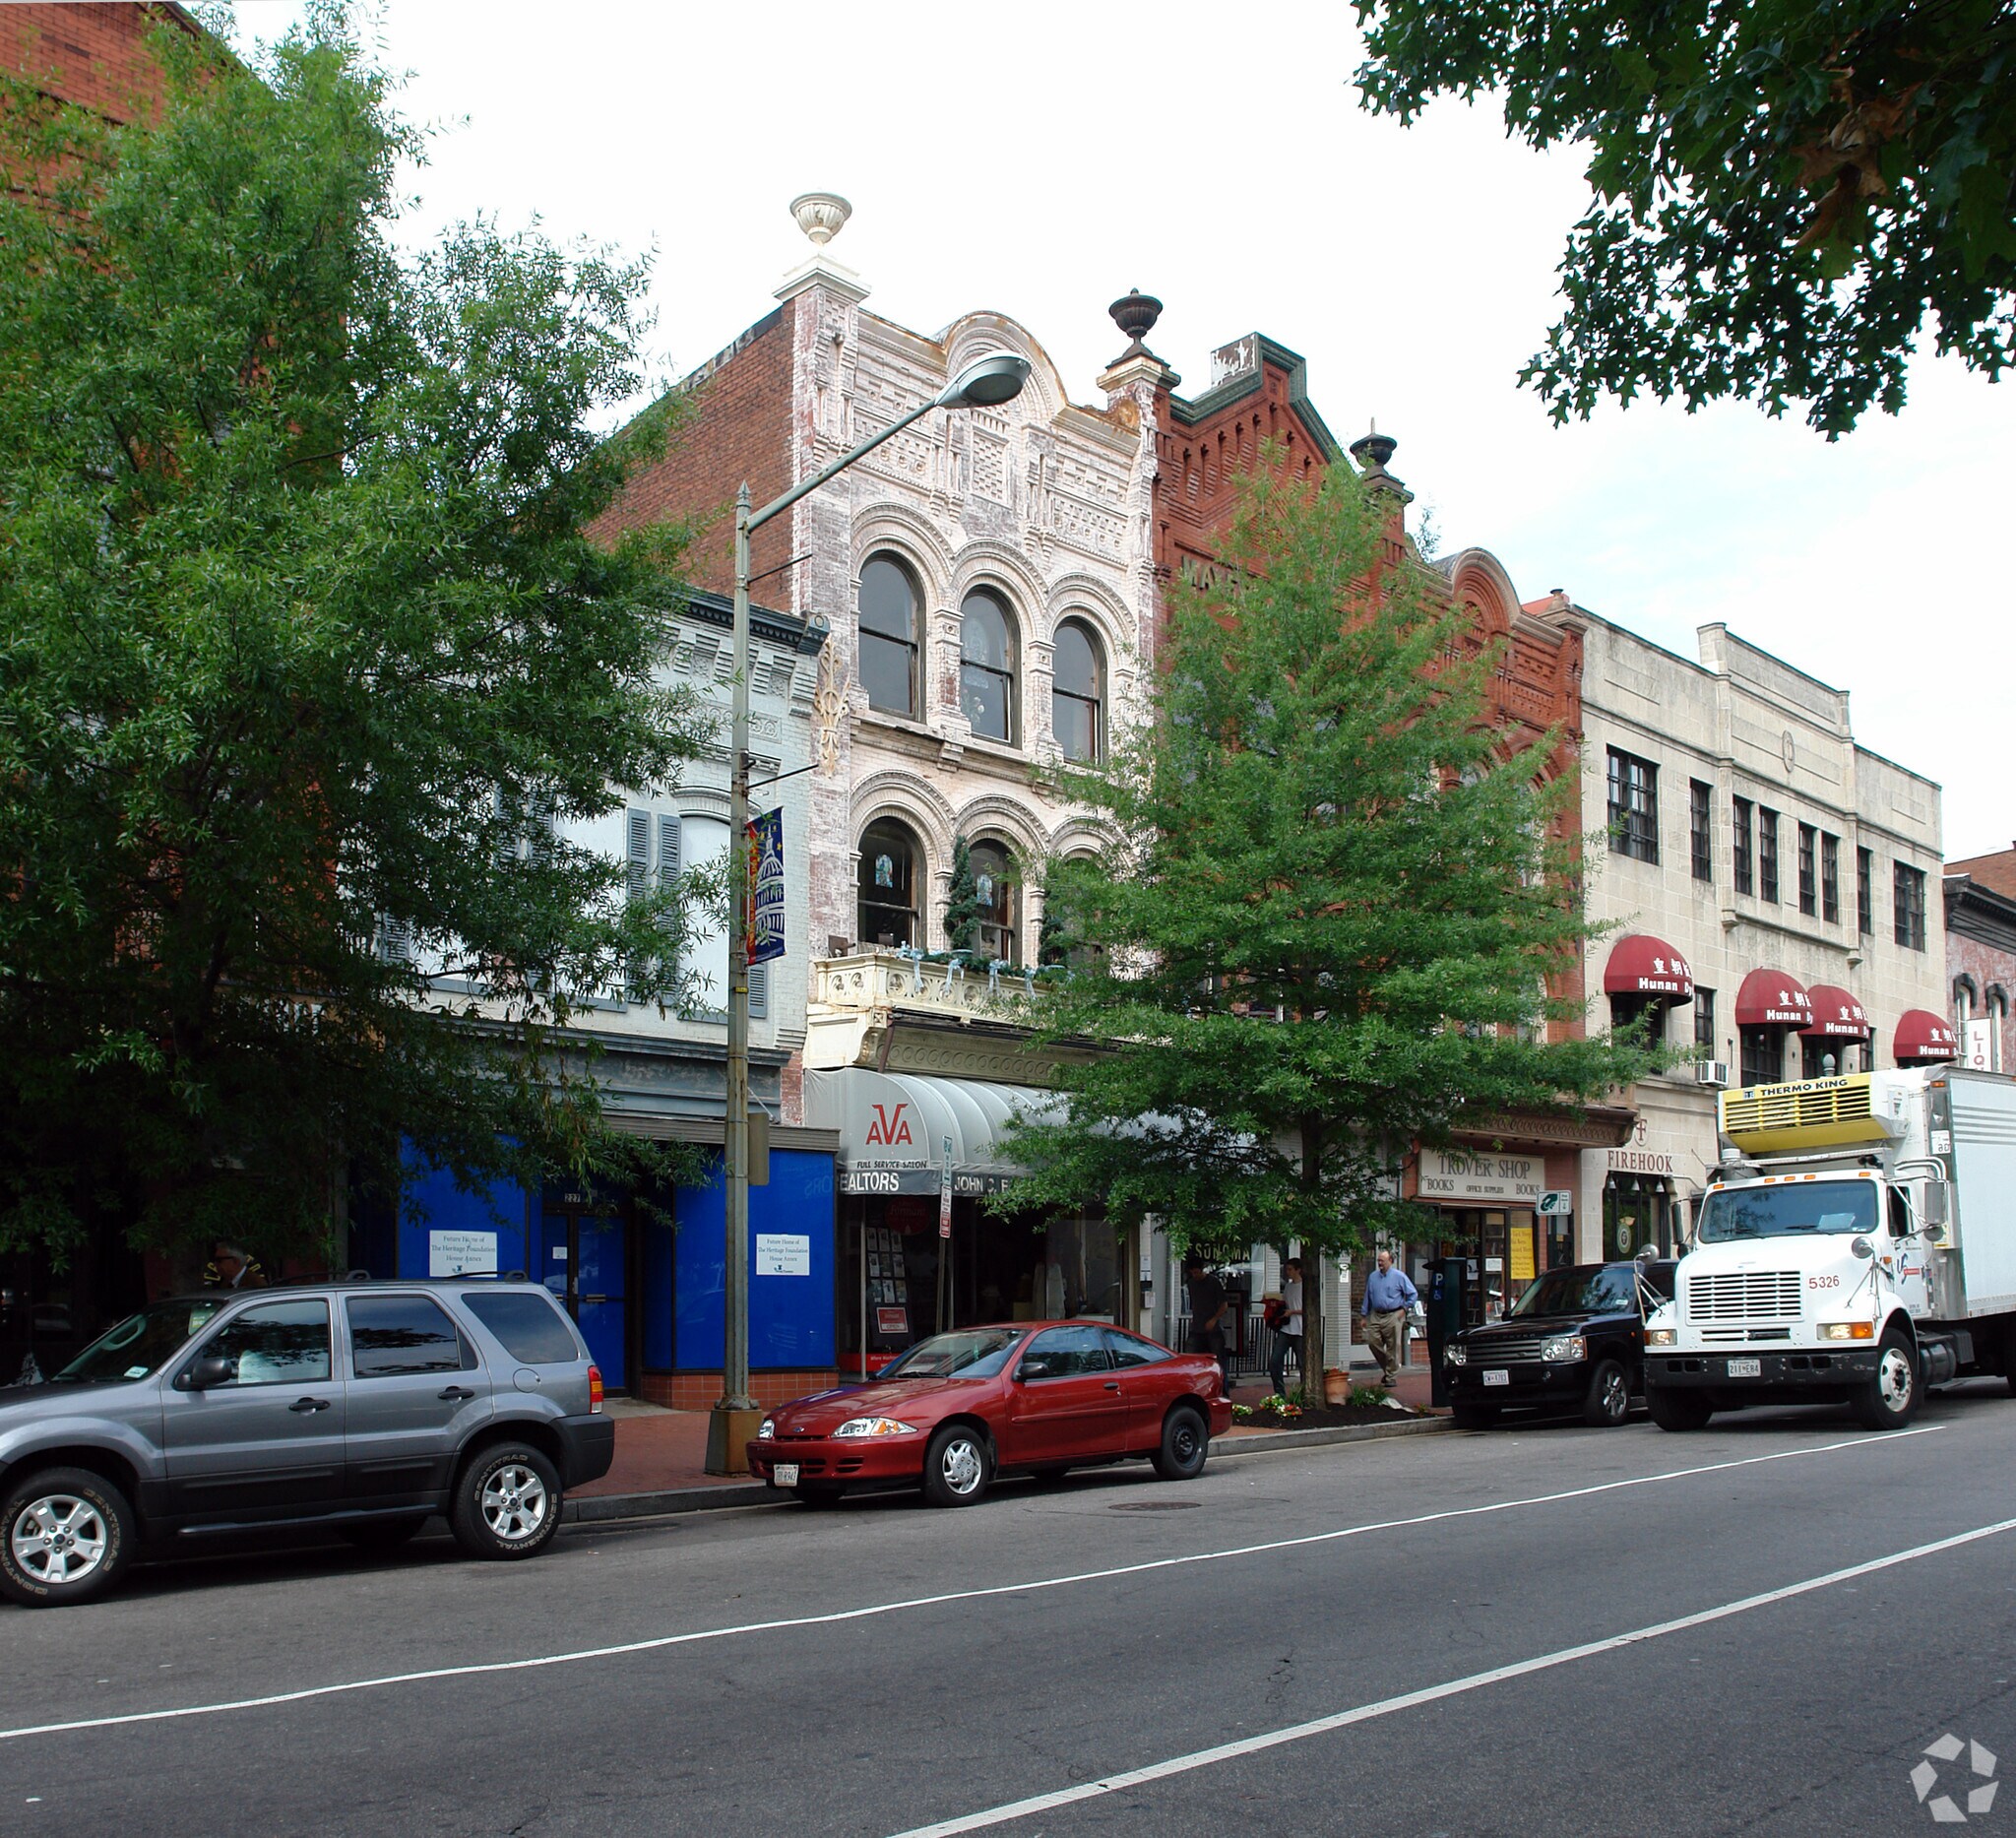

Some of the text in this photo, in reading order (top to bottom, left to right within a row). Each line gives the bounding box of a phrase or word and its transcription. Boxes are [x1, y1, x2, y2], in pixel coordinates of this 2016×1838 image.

[1638, 978, 1678, 991] Hunan
[1766, 1009, 1801, 1021] Hunan
[1825, 1023, 1858, 1034] Hunan
[1920, 1046, 1949, 1055] Hunan
[1974, 1031, 1984, 1071] LIQ
[1760, 1084, 1811, 1097] THERMO
[1815, 1079, 1849, 1090] KING
[865, 1104, 913, 1145] AVA
[1438, 1155, 1530, 1179] TROVER SHOP
[1607, 1150, 1673, 1173] FIREHOOK
[954, 1175, 983, 1191] JOHN
[1427, 1178, 1454, 1190] BOOKS
[1516, 1183, 1540, 1195] BOOKS
[566, 1193, 580, 1202] 227
[443, 1244, 466, 1253] Heritage
[1195, 1242, 1250, 1260] SONOMA
[1808, 1275, 1840, 1290] 5326
